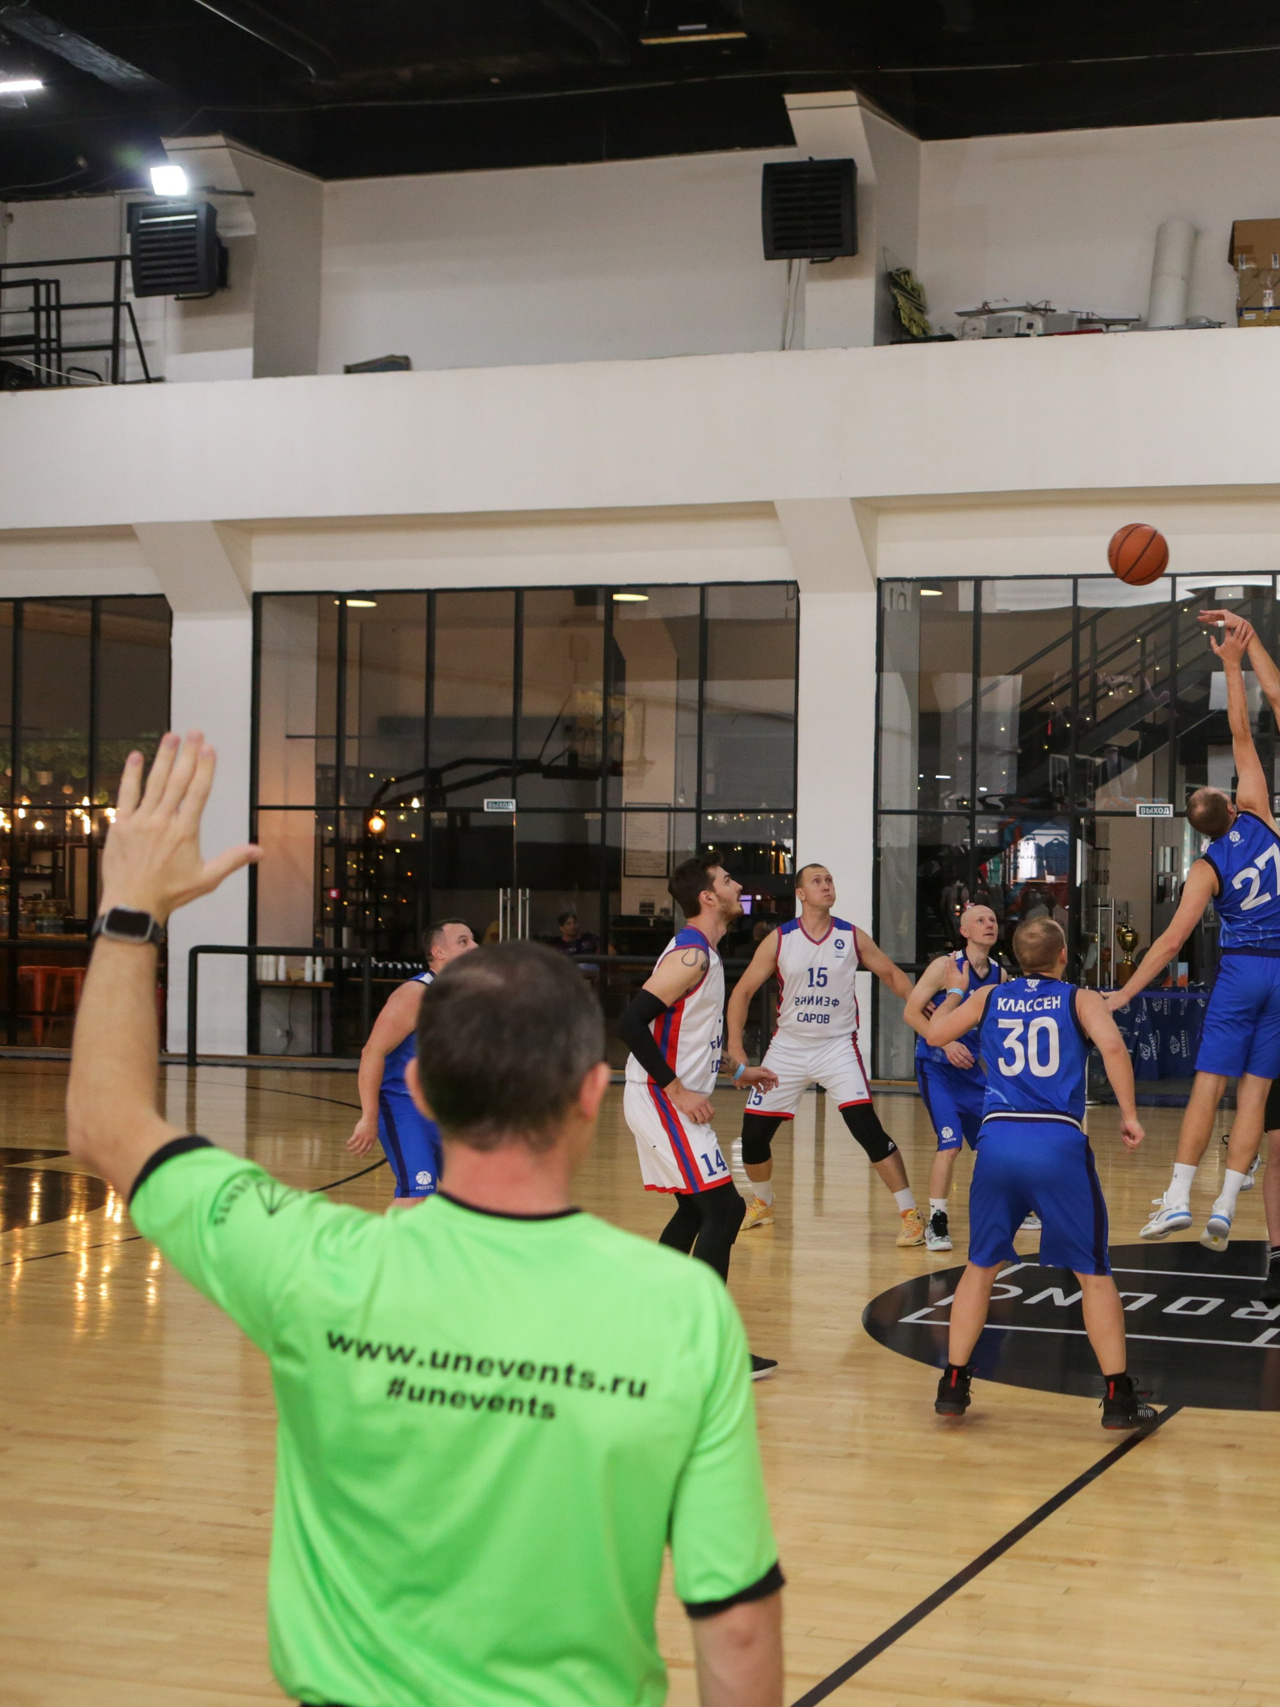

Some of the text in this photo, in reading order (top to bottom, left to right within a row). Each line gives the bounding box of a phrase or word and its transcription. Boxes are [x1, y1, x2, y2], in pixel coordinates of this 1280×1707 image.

[1140, 807, 1170, 815] ВЫХОД
[807, 967, 828, 988] 15
[997, 995, 1061, 1013] КЛАССЕН
[796, 1012, 831, 1024] САРОВ
[997, 1016, 1060, 1077] 30
[747, 1088, 763, 1106] 15
[701, 1149, 728, 1177] 14
[326, 1329, 648, 1400] www.unevents.ru
[386, 1376, 556, 1420] #unevents
